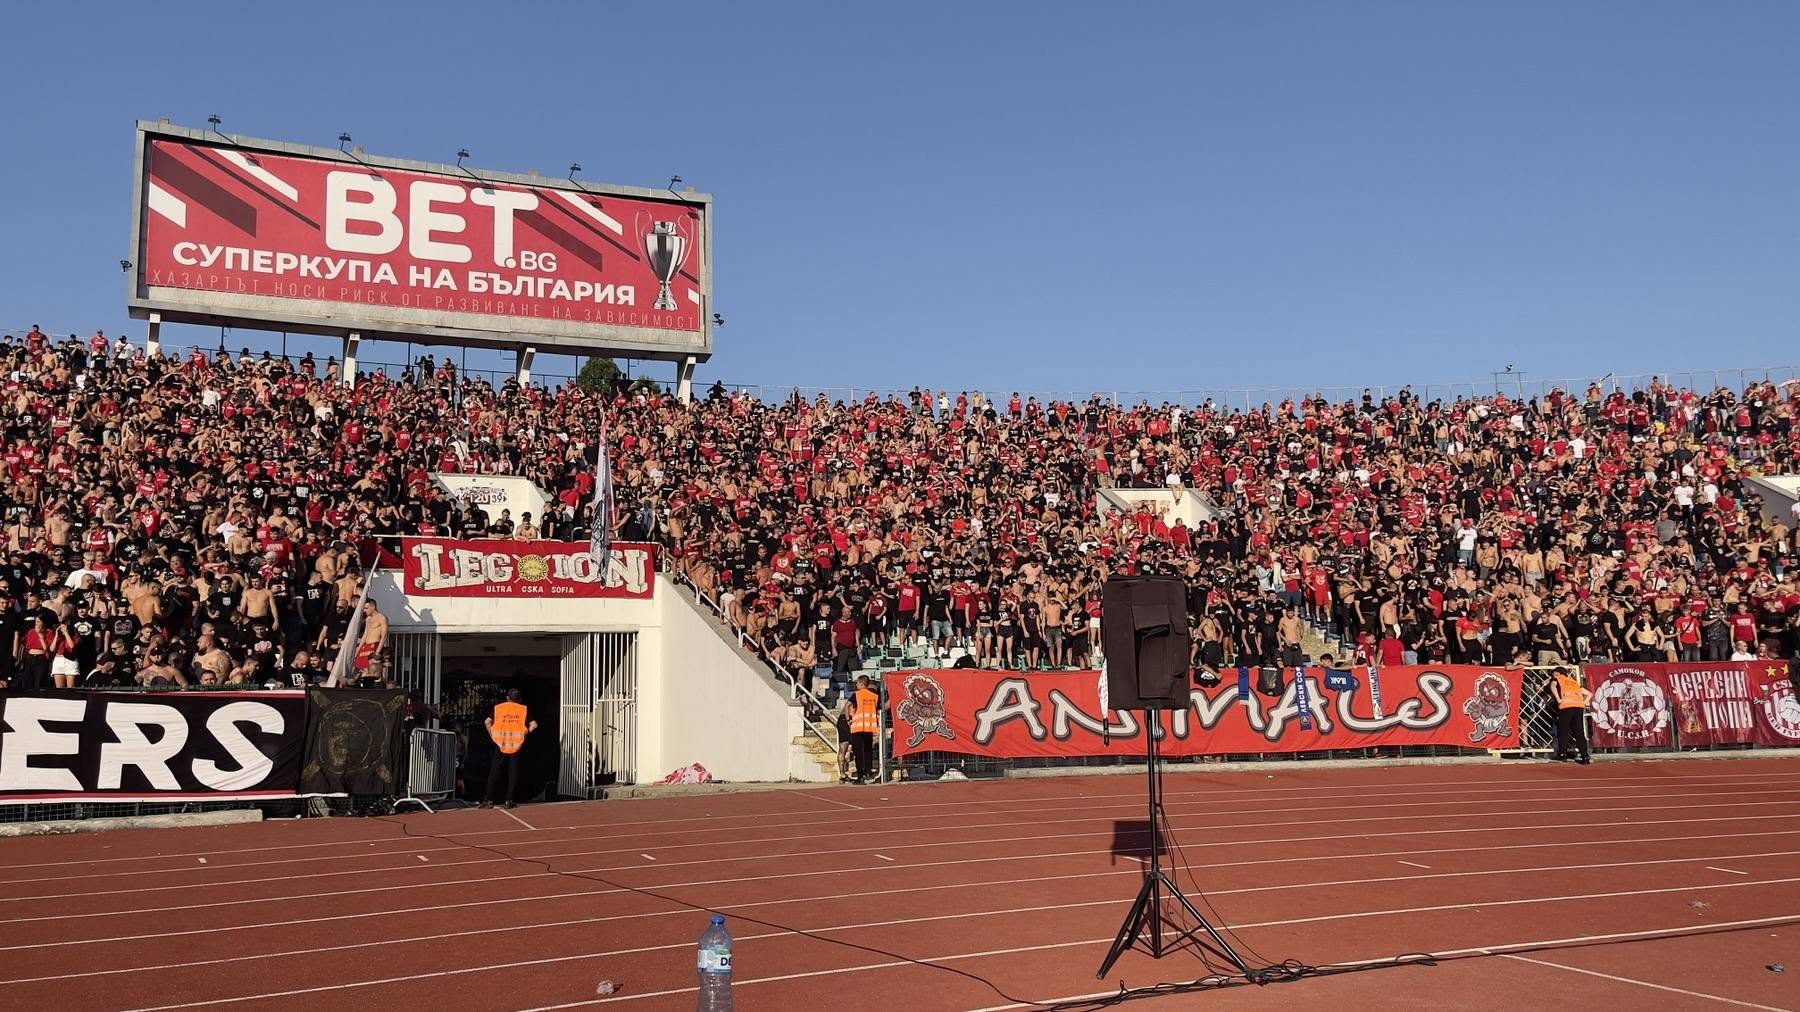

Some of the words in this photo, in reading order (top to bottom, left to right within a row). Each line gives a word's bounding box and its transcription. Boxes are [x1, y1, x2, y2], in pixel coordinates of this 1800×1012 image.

[153, 270, 259, 292] ХАЗАРТЪТ
[275, 282, 326, 299] НОСИ
[341, 287, 388, 304] РИСК
[402, 294, 420, 306] ОТ
[435, 295, 541, 316] РАЗВИВАНЕ
[553, 306, 572, 318] НА
[585, 308, 694, 329] ЗАВИСИМОСТ
[172, 241, 399, 286] СУПЕРКУПА
[409, 265, 458, 291] НА
[468, 271, 635, 306] БЪЛГАРИЯ
[486, 585, 513, 593] ULTRA
[521, 585, 544, 593] CSKA
[551, 586, 574, 594] SOFIA
[974, 672, 1453, 743] ANMALS
[0, 698, 285, 791] ERS
